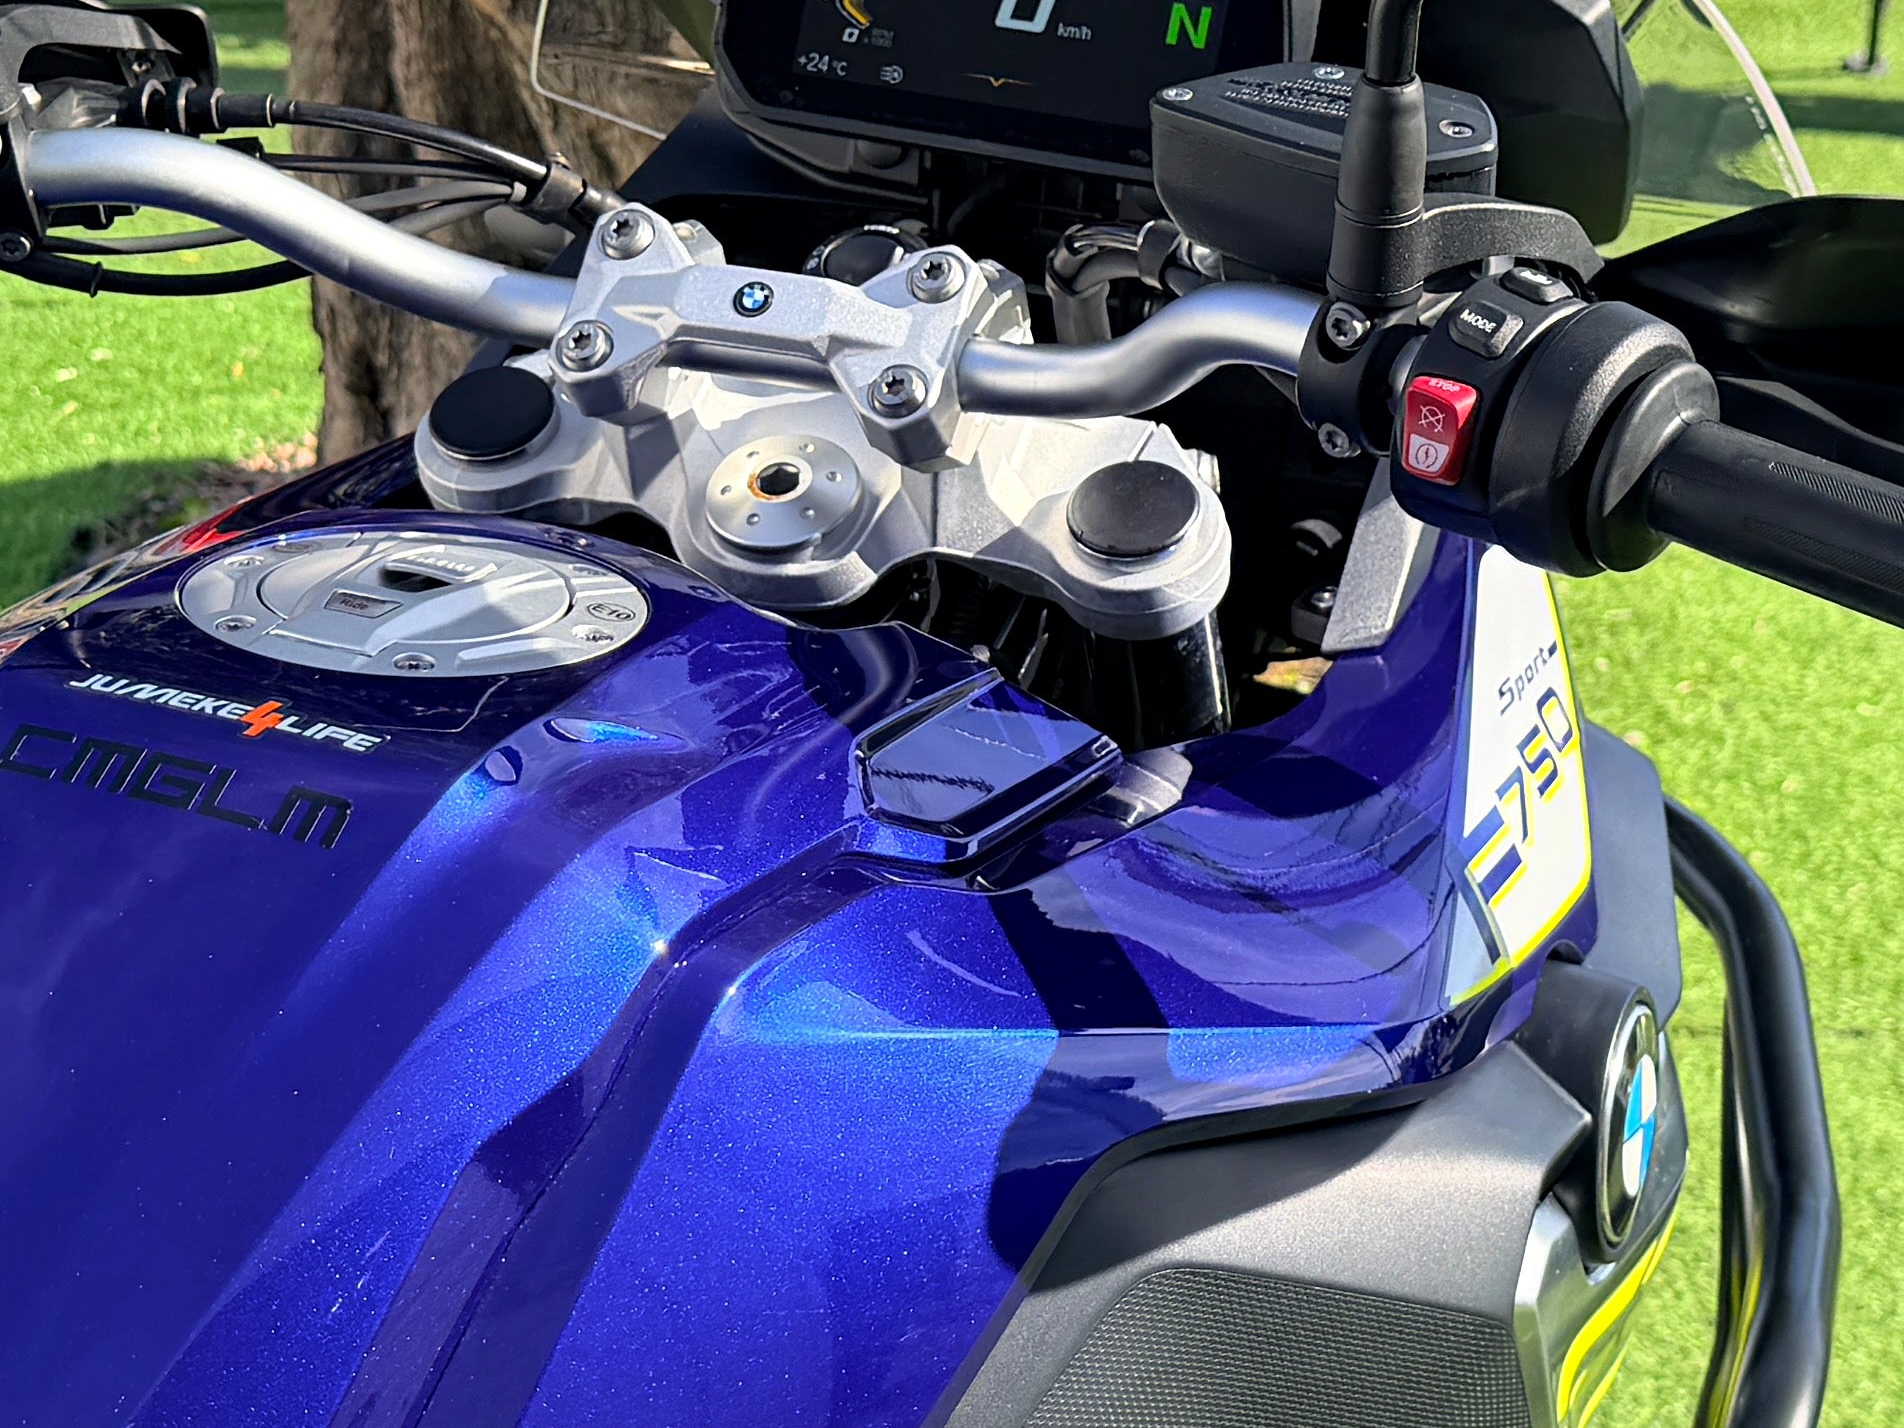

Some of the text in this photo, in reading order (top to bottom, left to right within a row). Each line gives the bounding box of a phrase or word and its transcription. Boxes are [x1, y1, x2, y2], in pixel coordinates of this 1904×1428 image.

[1057, 22, 1092, 41] km/h
[1164, 1, 1213, 50] N
[842, 27, 860, 44] 0
[1459, 308, 1497, 334] MODE
[1428, 377, 1461, 392] STOP
[591, 603, 631, 622] E10
[1498, 646, 1548, 716] Sport
